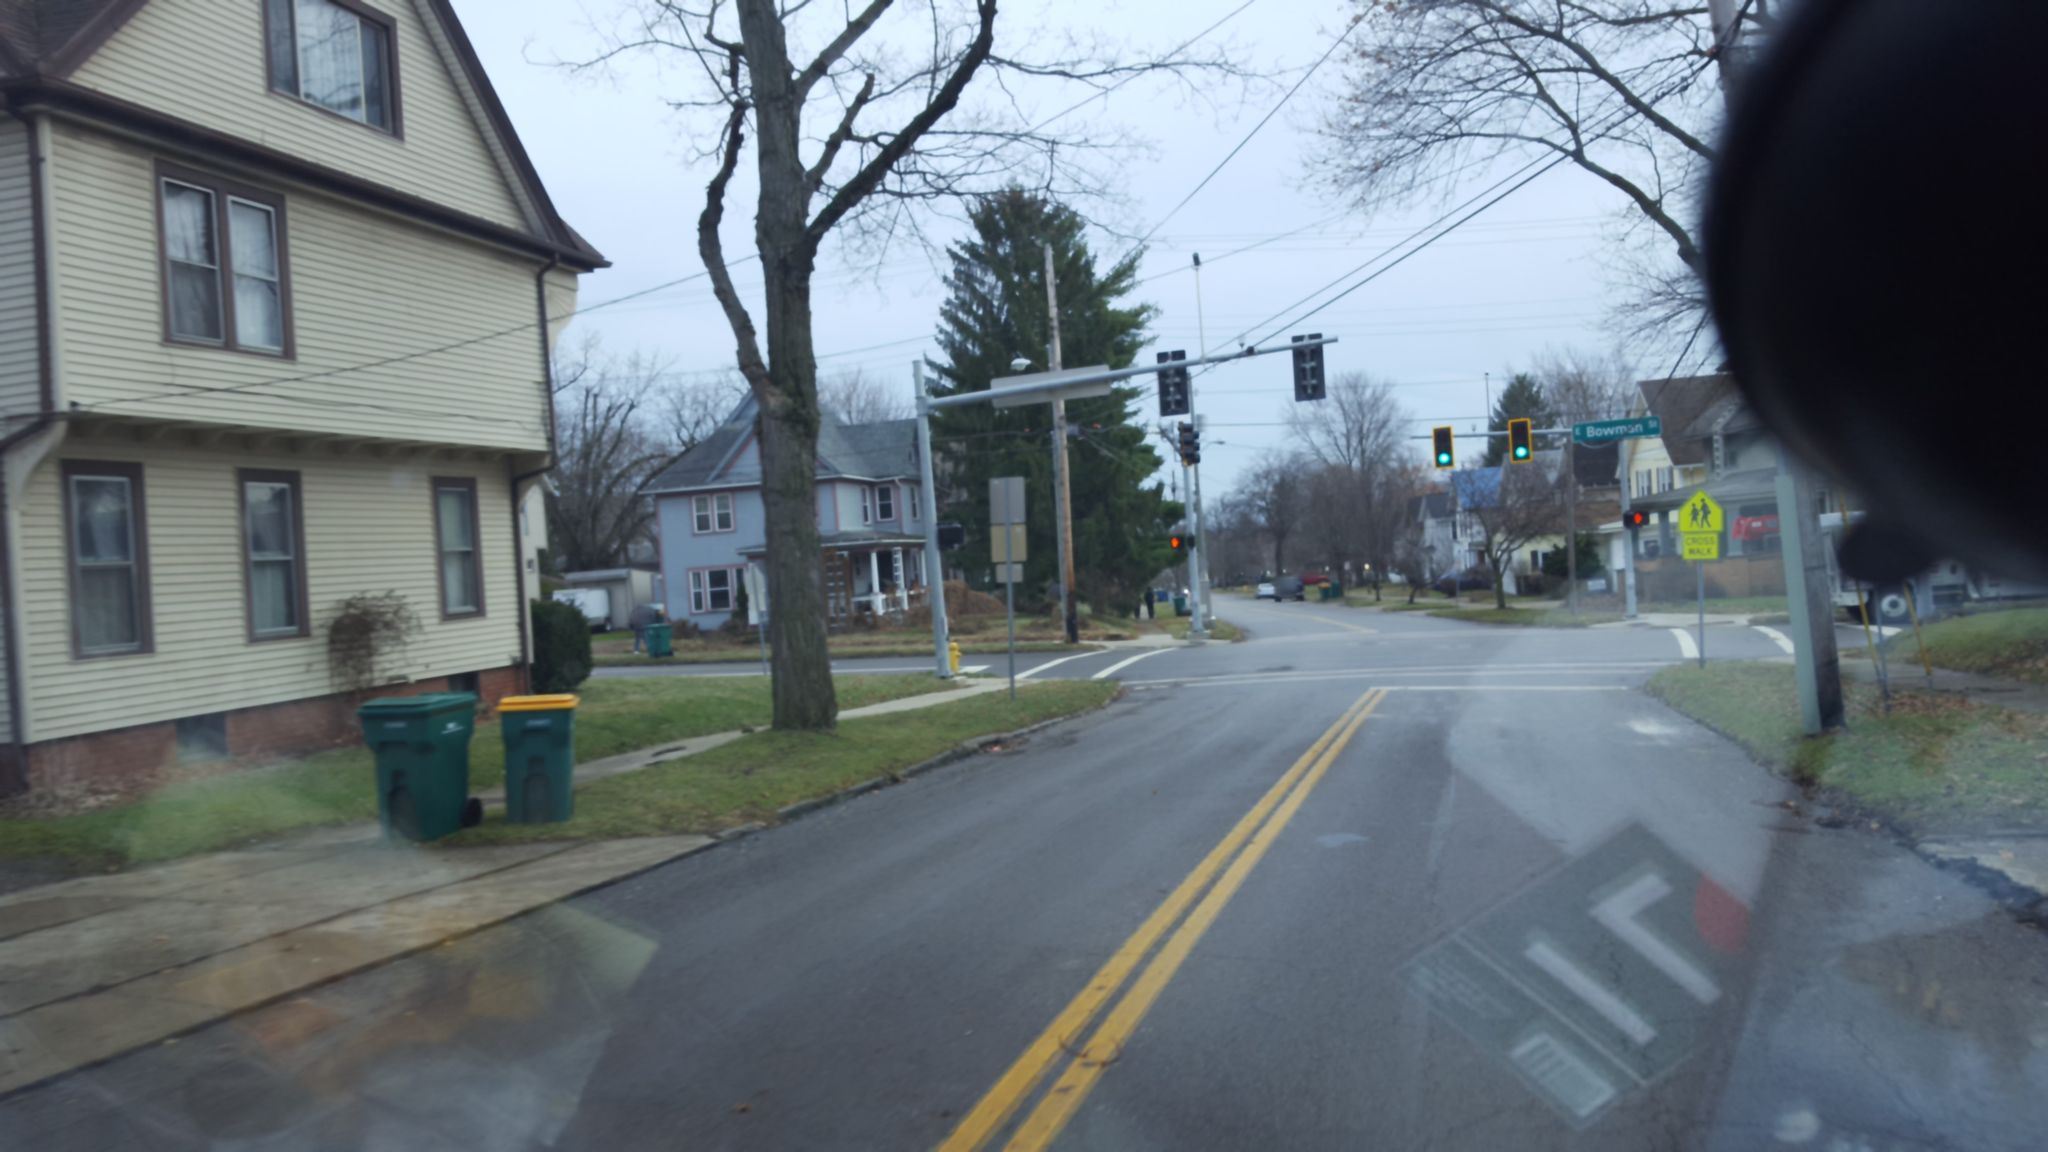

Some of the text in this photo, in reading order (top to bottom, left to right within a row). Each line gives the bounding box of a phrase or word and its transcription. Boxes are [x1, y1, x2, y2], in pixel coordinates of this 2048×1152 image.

[1586, 423, 1643, 438] Bowman
[1684, 535, 1715, 545] CROSS
[1688, 547, 1712, 556] WALK
